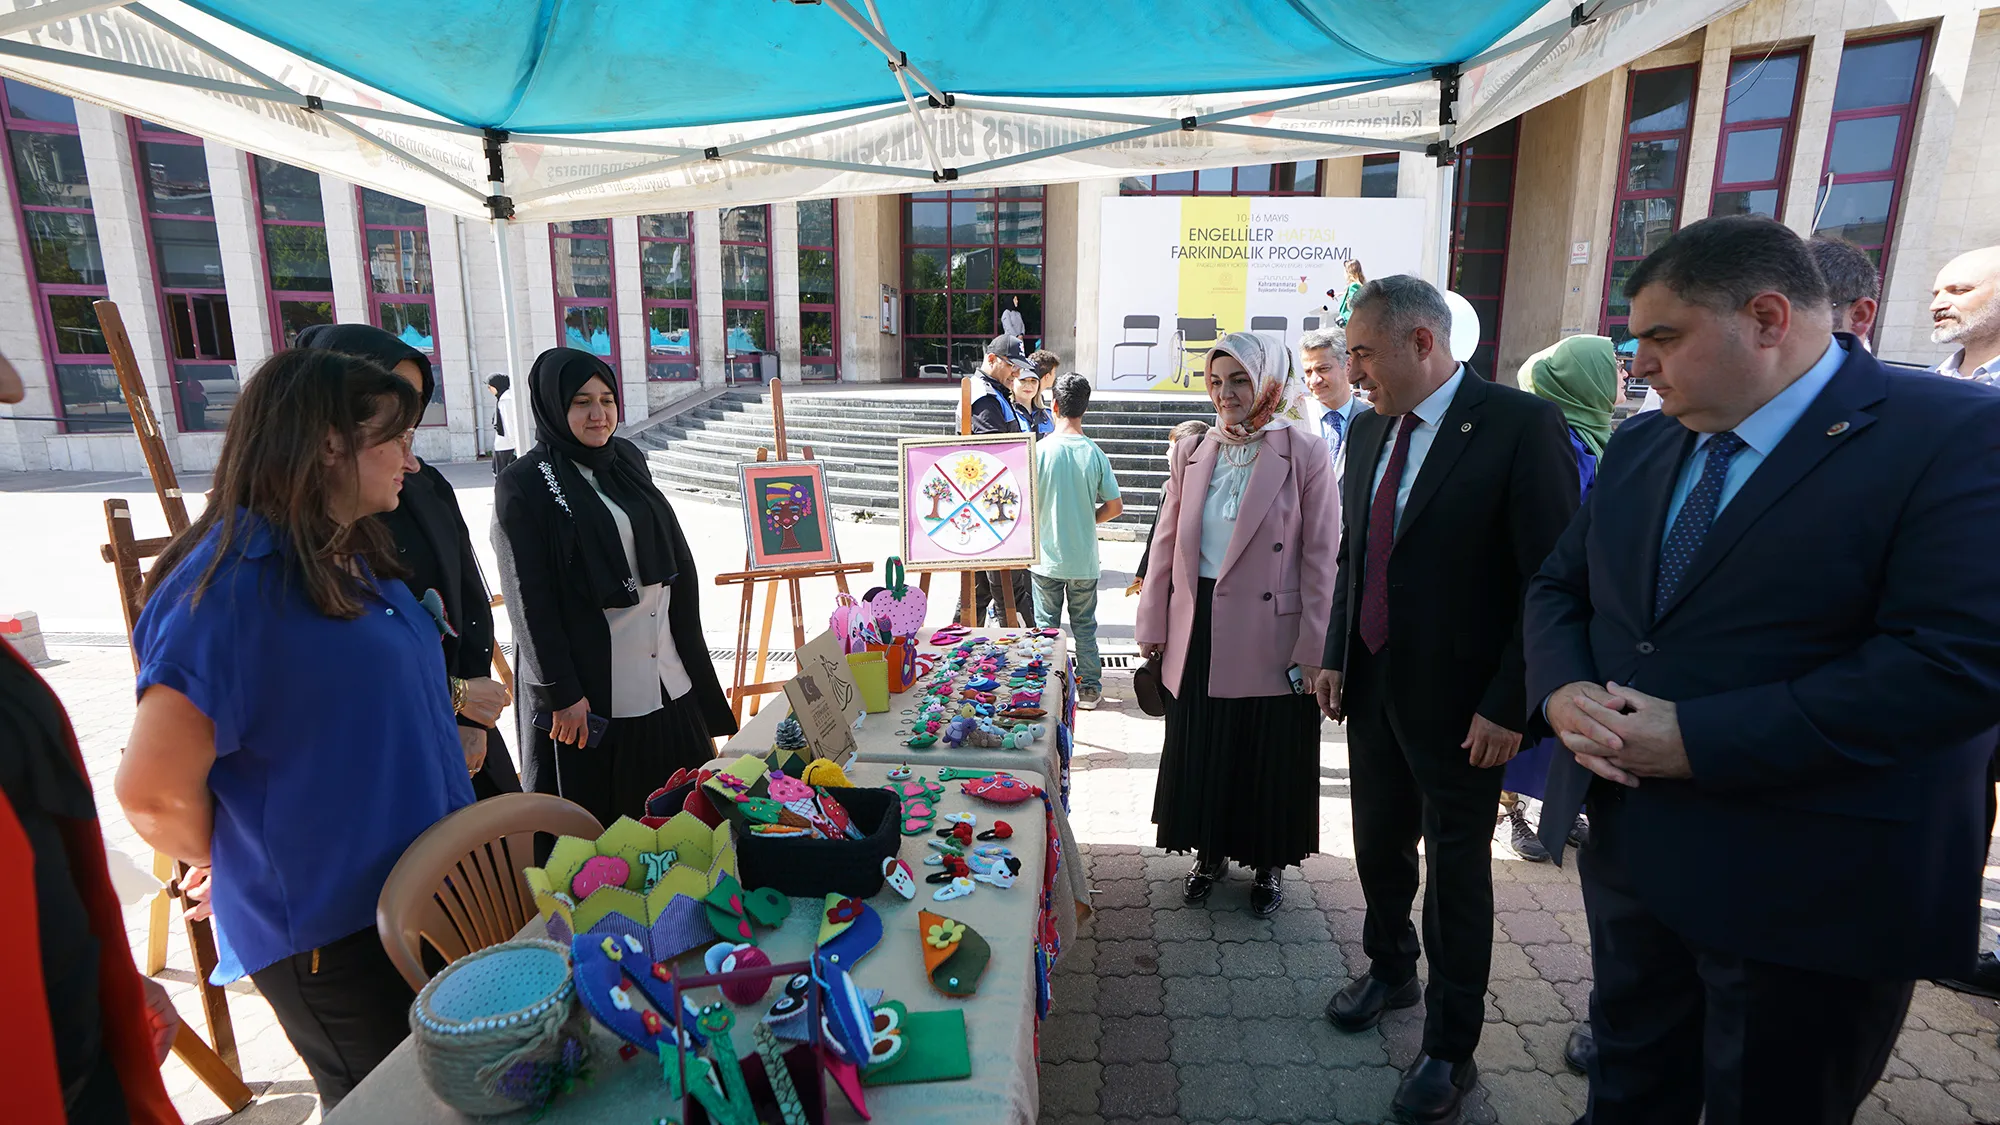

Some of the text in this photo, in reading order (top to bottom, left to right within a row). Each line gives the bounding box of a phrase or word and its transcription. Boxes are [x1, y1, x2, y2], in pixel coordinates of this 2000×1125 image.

[1236, 213, 1290, 223] 10-16 MAYIS
[1188, 224, 1336, 242] ENGELLİLER HAFTASI
[1171, 245, 1352, 260] FARKINDALIK PROGRAMI
